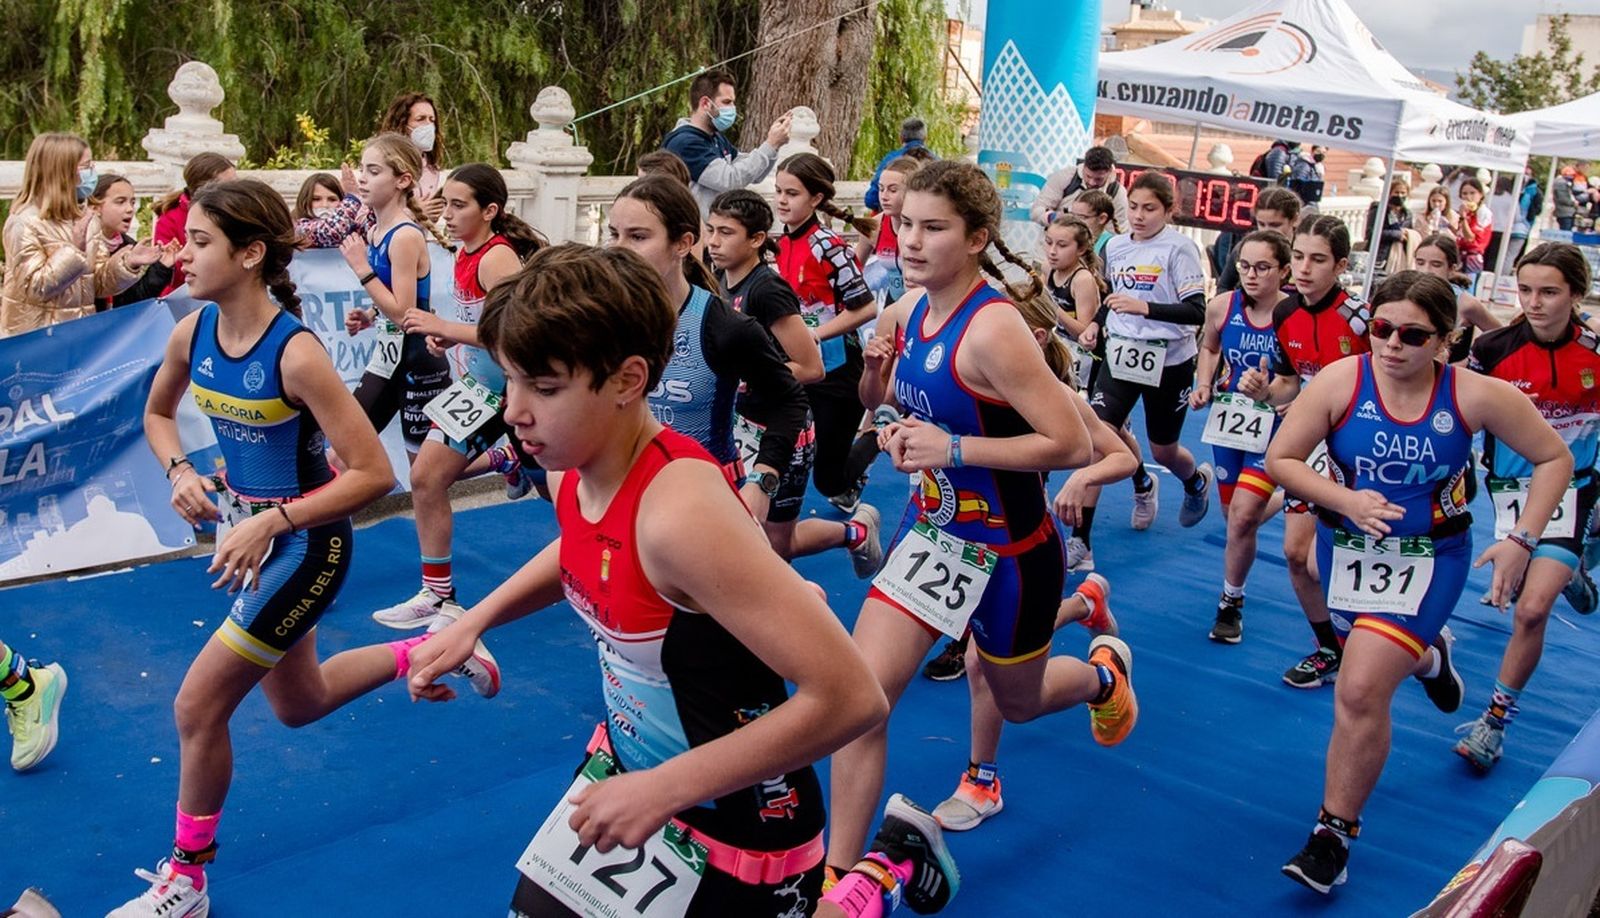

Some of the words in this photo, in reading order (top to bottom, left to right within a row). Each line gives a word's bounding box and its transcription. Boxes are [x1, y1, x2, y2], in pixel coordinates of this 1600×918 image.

[1114, 345, 1156, 372] 136
[220, 402, 267, 421] CORIA
[441, 390, 483, 427] 129
[1216, 410, 1263, 438] 124
[1372, 431, 1437, 462] SABA
[1355, 455, 1450, 485] RCM
[275, 598, 316, 636] CORIA
[309, 568, 336, 596] DEL
[327, 536, 342, 564] RIO
[904, 550, 973, 610] 125
[1347, 559, 1415, 595] 131
